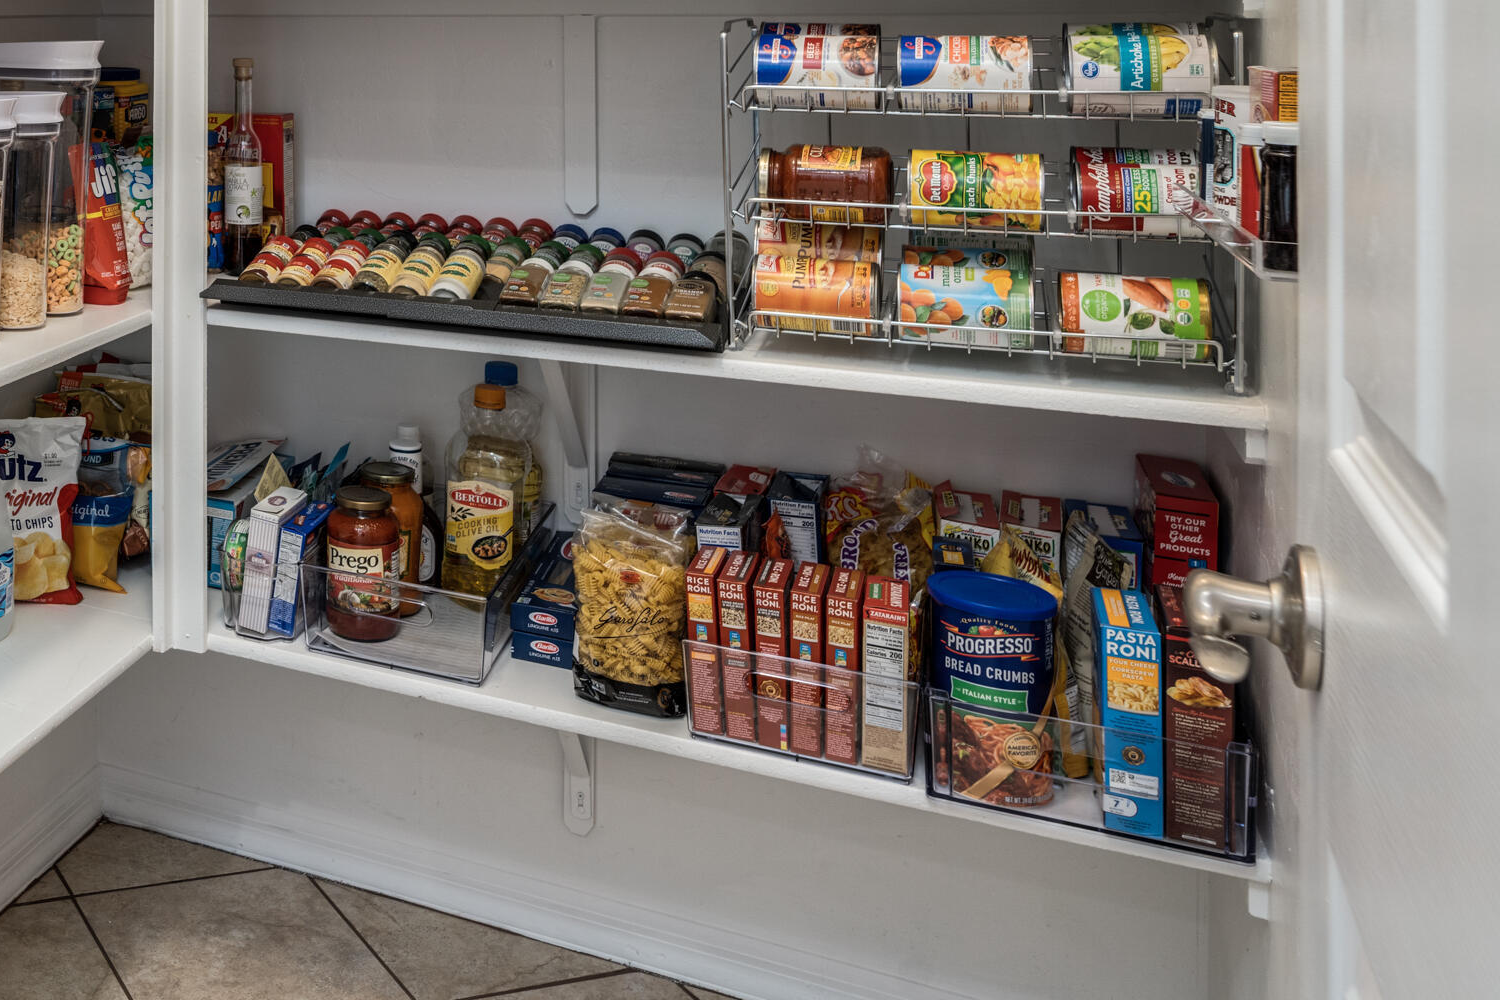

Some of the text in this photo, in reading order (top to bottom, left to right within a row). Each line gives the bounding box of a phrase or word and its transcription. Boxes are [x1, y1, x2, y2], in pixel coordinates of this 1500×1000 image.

[806, 41, 816, 59] BEEF
[1129, 43, 1144, 89] Artichoke
[966, 157, 977, 184] Chunks
[1132, 169, 1141, 184] LESS
[91, 163, 118, 198] Jif
[930, 161, 942, 202] Del Monte
[1165, 181, 1173, 204] Cream
[454, 490, 503, 509] BERTOLLI
[796, 503, 814, 511] Facts
[25, 516, 54, 530] CHIPS
[457, 517, 500, 531] COOKING
[801, 520, 815, 528] 200
[1164, 514, 1207, 528] TRY OUR
[1170, 523, 1201, 533] OTHER
[456, 525, 500, 540] OLIVE OIL
[699, 527, 740, 538] Nutrition Facts
[1168, 529, 1204, 544] Great
[1159, 542, 1212, 557] PRODUCTS
[330, 547, 380, 575] Prego
[686, 576, 710, 586] RICE
[719, 582, 743, 592] RICE
[755, 590, 779, 600] RICE
[791, 593, 817, 605] RICE
[828, 598, 853, 610] RICE
[1124, 594, 1145, 625] PASTA RONI
[535, 613, 556, 626] Barilla
[594, 606, 667, 633] Garofalo
[960, 617, 1019, 633] Quality Foods
[527, 622, 549, 632] LINGUINE
[866, 623, 903, 636] Nutrition Facts
[947, 631, 1033, 655] PROGRESSO
[1105, 627, 1157, 647] PASTA
[536, 642, 557, 653] Barilla
[866, 647, 903, 661] Calories 200
[944, 655, 1036, 685] BREAD CRUMBS
[1108, 657, 1157, 670] FOUR CHEESE
[1110, 665, 1155, 678] CORKSCREW
[1121, 673, 1145, 682] PASTA
[961, 688, 1017, 706] ITALIAN STYLE
[1007, 749, 1038, 757] FAVORITE
